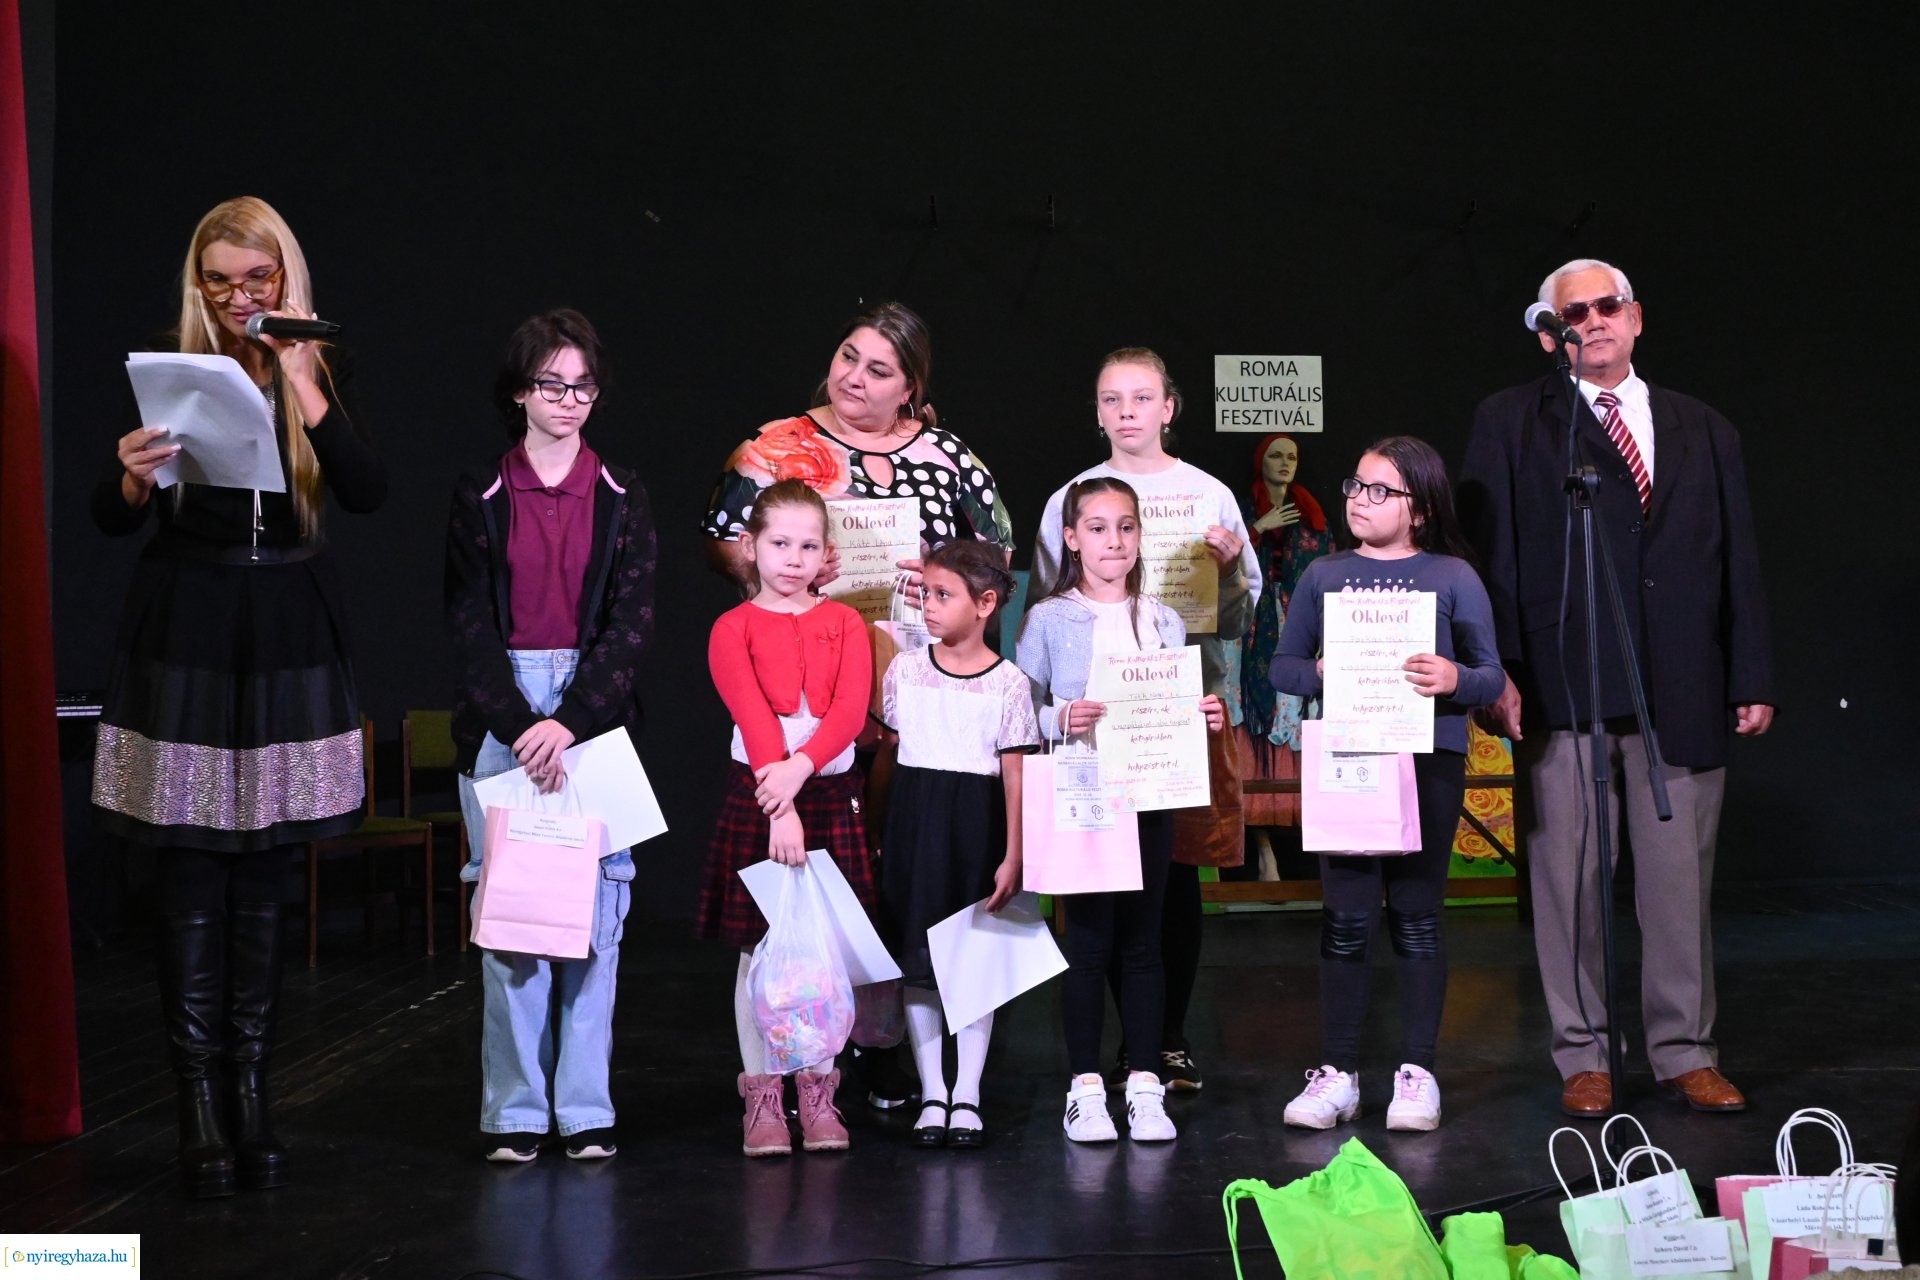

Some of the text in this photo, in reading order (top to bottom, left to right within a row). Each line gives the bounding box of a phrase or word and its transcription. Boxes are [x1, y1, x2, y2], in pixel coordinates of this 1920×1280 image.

[1240, 361, 1298, 376] ROMA
[1215, 382, 1322, 402] KULTURÁLIS
[1221, 406, 1315, 425] FESZTIVÁL
[1143, 505, 1194, 518] Oklevél
[842, 515, 896, 530] Oklevél
[1352, 610, 1408, 623] Oklevél
[1121, 665, 1178, 682] Oklevél
